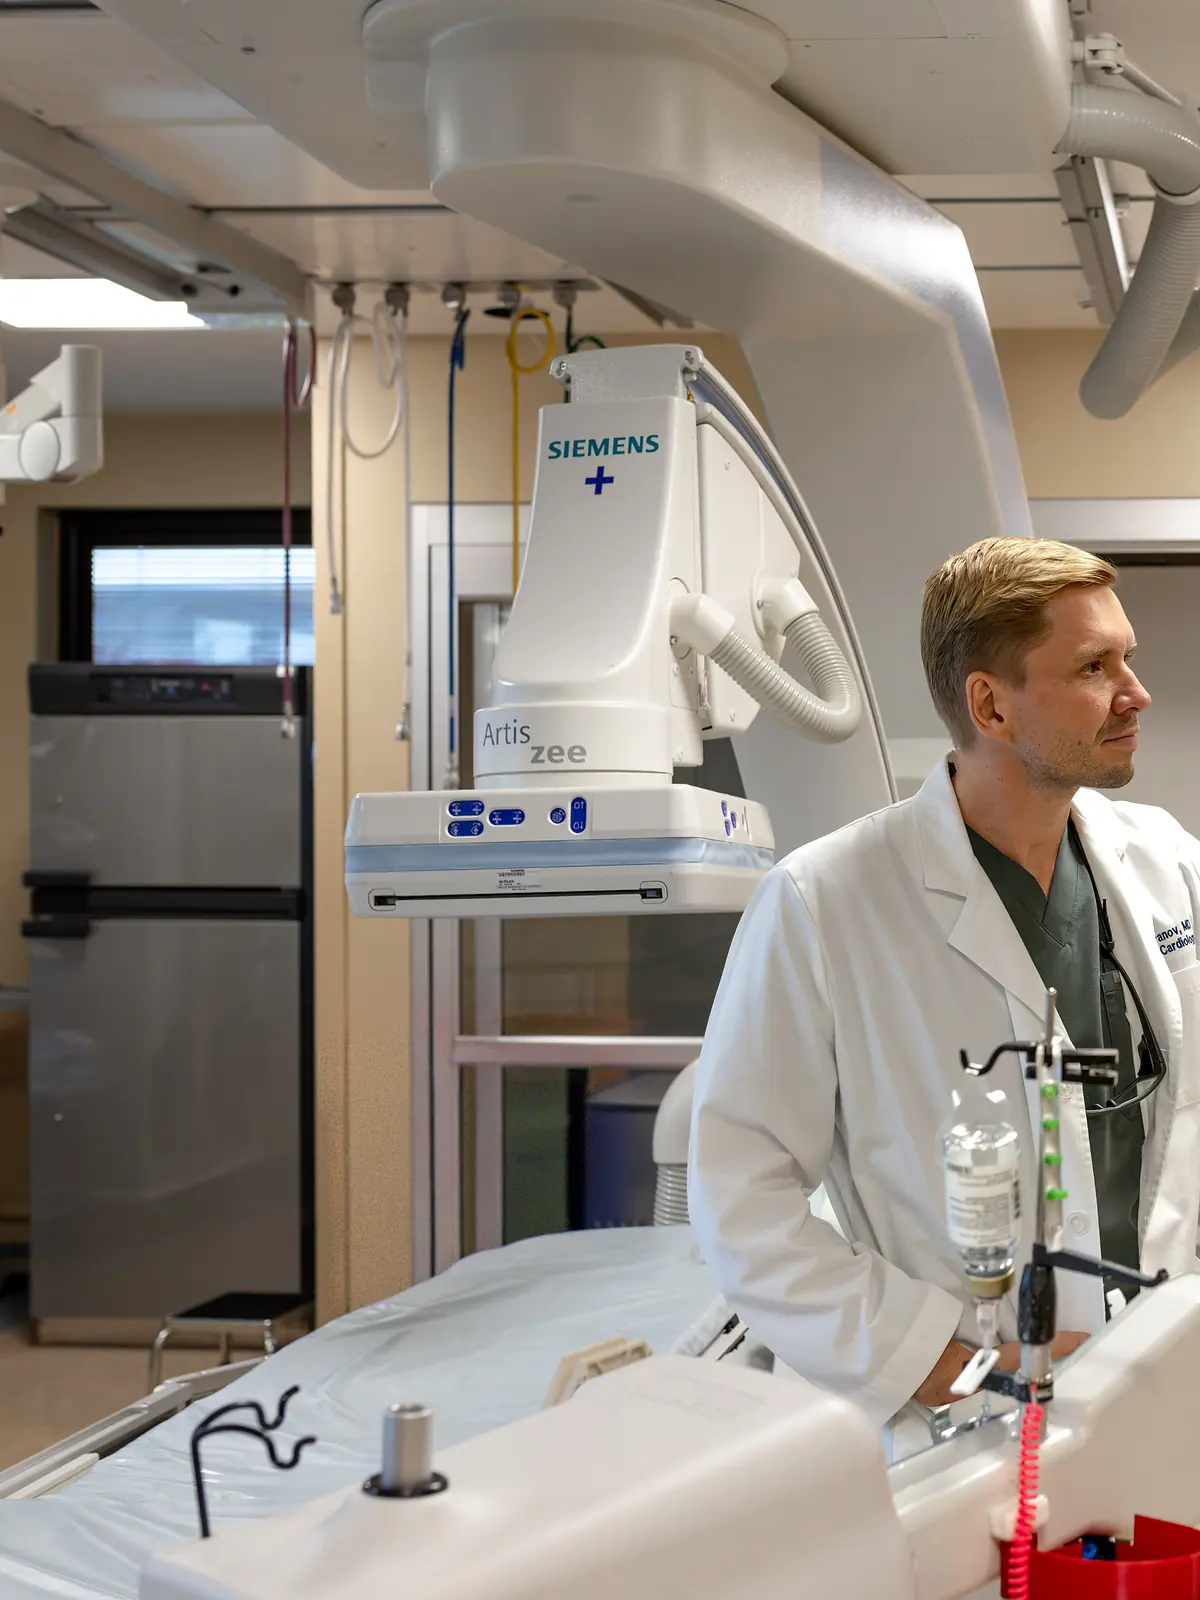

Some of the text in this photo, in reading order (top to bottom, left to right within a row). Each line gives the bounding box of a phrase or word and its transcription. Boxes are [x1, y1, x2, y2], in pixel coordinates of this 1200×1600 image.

[548, 434, 660, 459] SIEMENS
[483, 719, 531, 747] Artis
[530, 745, 587, 764] zee
